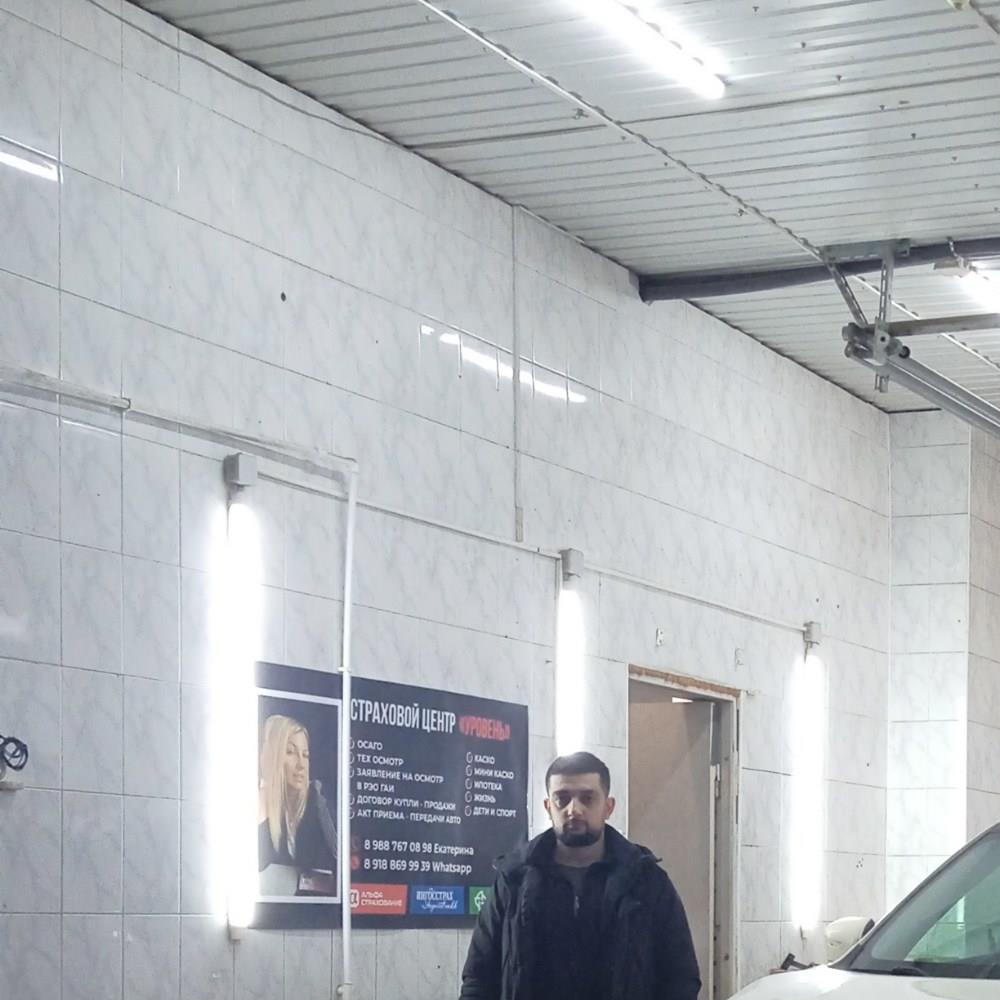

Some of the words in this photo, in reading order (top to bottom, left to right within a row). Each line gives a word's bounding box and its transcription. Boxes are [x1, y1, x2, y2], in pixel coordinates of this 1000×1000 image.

[350, 698, 419, 730] СТРАХОВОЙ
[423, 711, 456, 734] ЦЕНТР
[357, 740, 383, 751] ОСАГО
[357, 755, 371, 764] ТЕХ
[373, 756, 404, 766] ОСМОТР
[474, 755, 495, 764] КАСКО
[357, 768, 400, 781] ЗАЯВЛЕНИЕ
[402, 773, 413, 781] НА
[415, 773, 444, 784] ОСМОТР
[474, 768, 492, 778] МИНИ
[493, 771, 514, 780] КАСКО
[357, 783, 362, 791] В
[363, 783, 379, 792] РЭО
[380, 784, 394, 793] ГАИ
[474, 781, 502, 792] ИПОТЕКА
[357, 795, 391, 807] ДОГОВОР
[394, 798, 419, 809] КУПЛИ
[424, 801, 456, 811] ПРОДАЖИ
[473, 794, 496, 803] ЖИЗНЬ
[357, 809, 371, 819] АКТ
[373, 810, 404, 820] ПРИЕМА
[410, 814, 445, 824] ПЕРЕДАЧИ
[446, 816, 461, 825] АВТО
[473, 807, 488, 817] ДЕТИ
[490, 809, 495, 817] И
[497, 808, 516, 818] СПОРТ
[364, 840, 370, 850] 8
[372, 841, 389, 851] 988
[392, 841, 408, 852] 767
[410, 842, 421, 852] 08
[423, 843, 432, 853] 98
[434, 843, 474, 856] Екатерина
[364, 859, 370, 870] 8
[372, 860, 388, 870] 918
[390, 860, 406, 871] 869
[408, 861, 419, 872] 99
[420, 862, 430, 872] 39
[432, 862, 471, 875] Whatsapp
[361, 898, 402, 908] СТРАХОВАНИЕ
